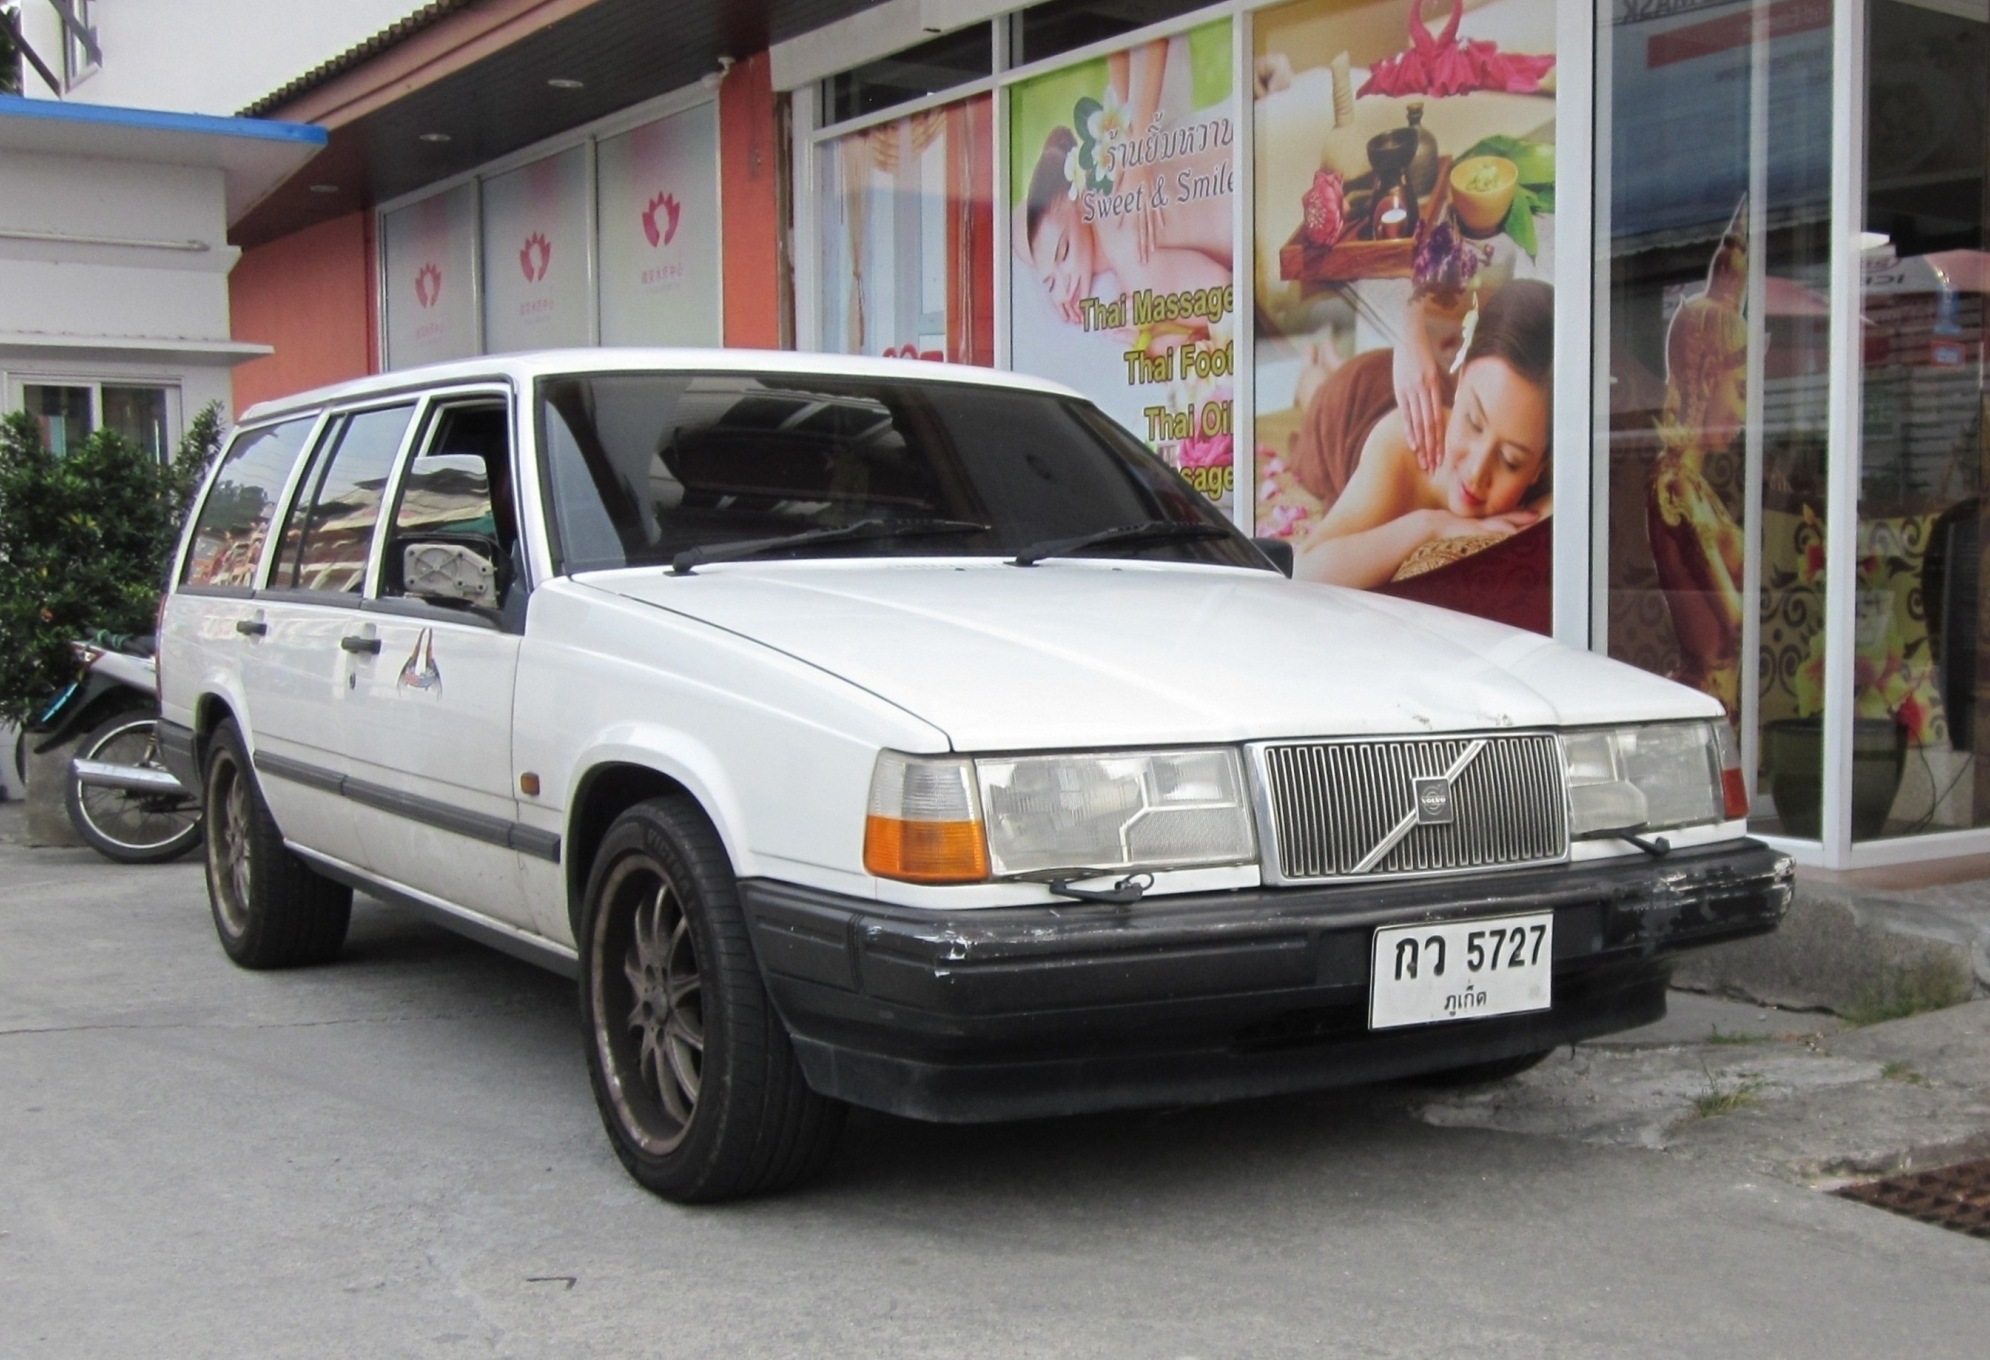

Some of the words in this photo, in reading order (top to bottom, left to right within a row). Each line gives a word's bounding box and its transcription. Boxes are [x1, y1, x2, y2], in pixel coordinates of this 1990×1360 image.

[1106, 112, 1233, 172] ร้านยิ้มหวาน
[1083, 185, 1143, 222] Sweet
[1151, 176, 1169, 209] &
[1177, 162, 1233, 203] Smile
[1080, 293, 1127, 332] Thai
[1133, 284, 1233, 326] Massage
[1124, 346, 1173, 385] Thai
[1180, 342, 1233, 380] Foot
[1144, 404, 1195, 441] Thai
[1202, 400, 1233, 437] Oil
[1395, 935, 1446, 981] กว
[1467, 924, 1547, 973] 5727
